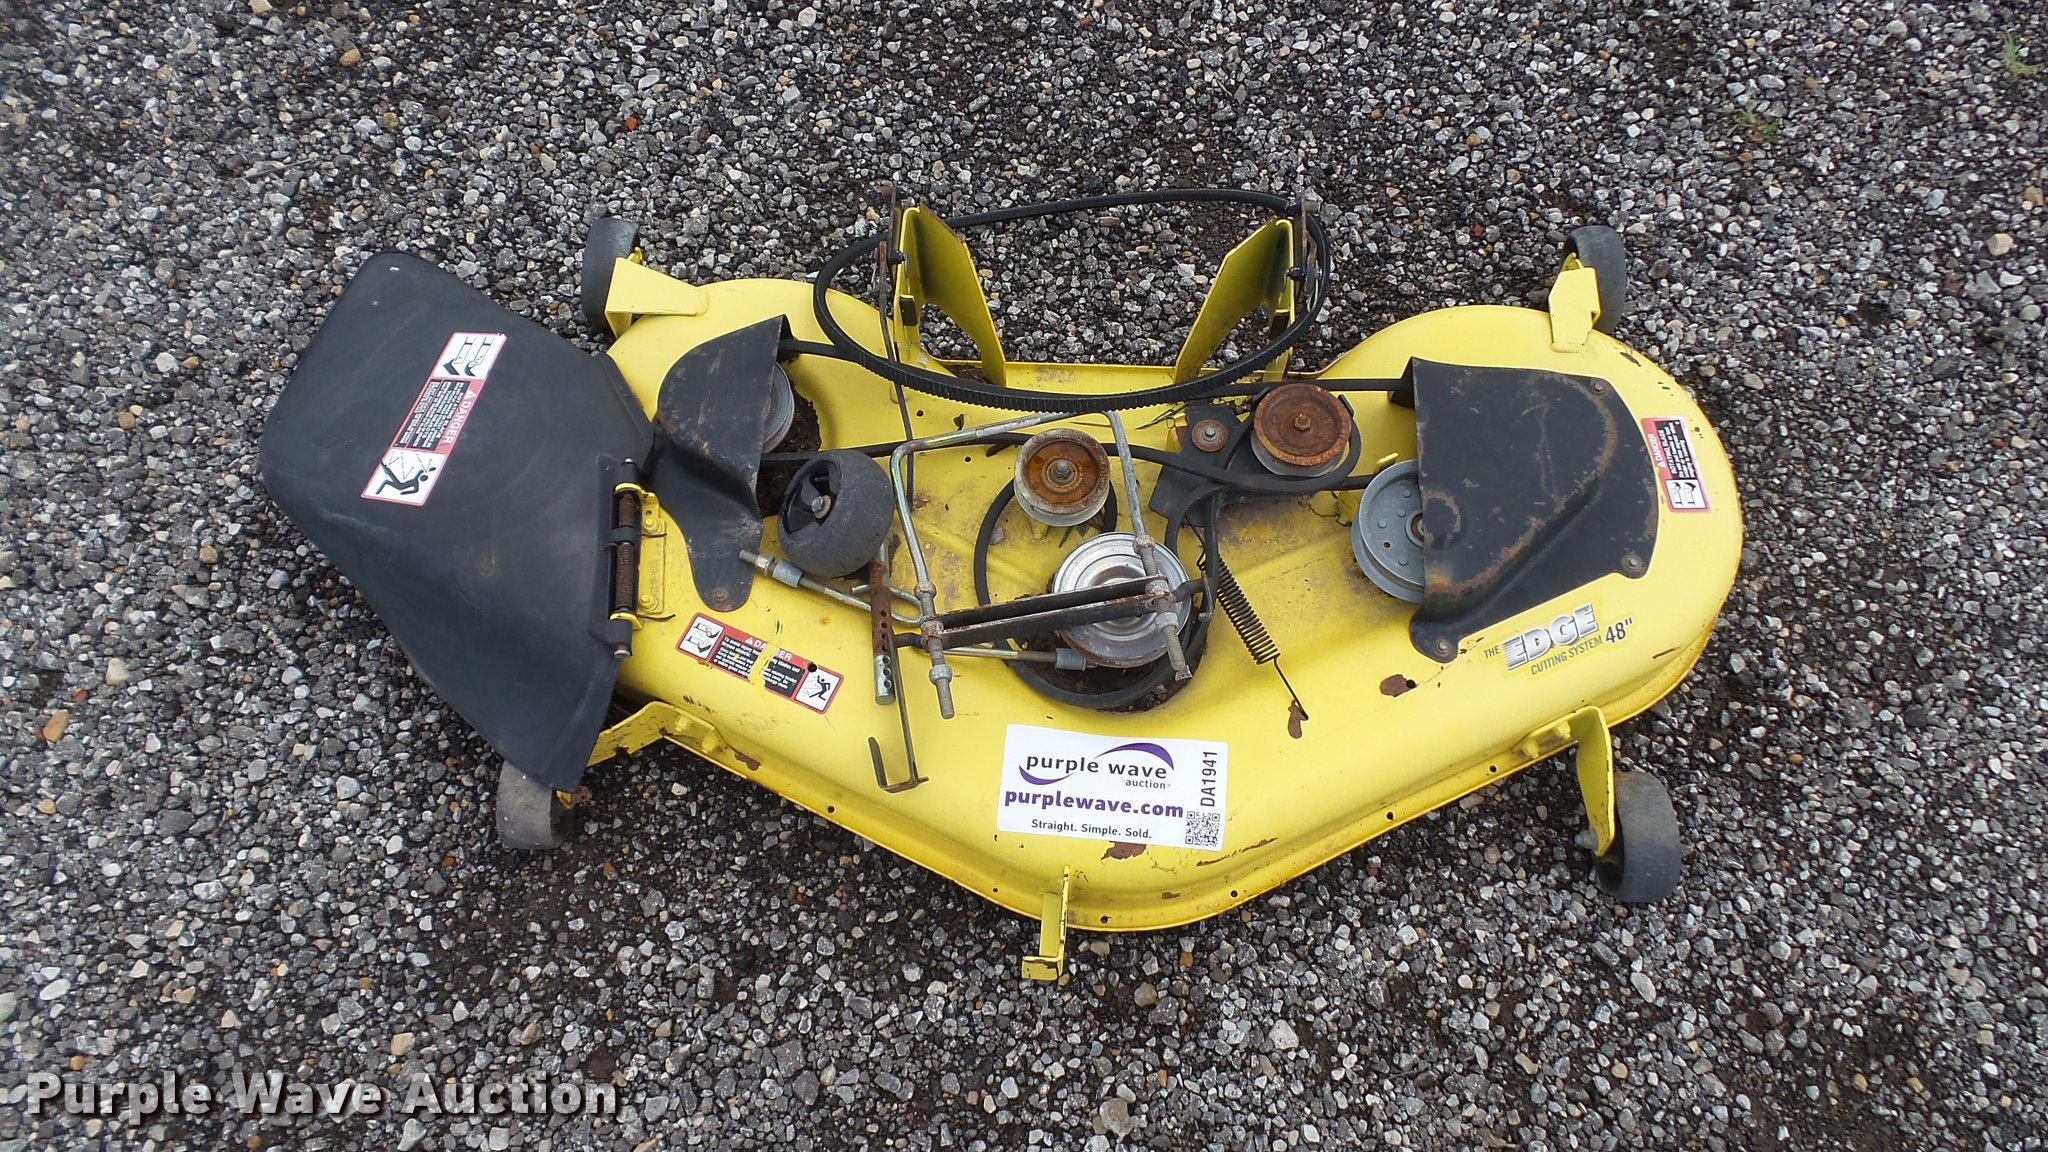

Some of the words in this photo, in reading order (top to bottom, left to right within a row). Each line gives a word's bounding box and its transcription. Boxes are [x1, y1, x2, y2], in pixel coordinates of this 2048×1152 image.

[442, 401, 472, 443] DANGER
[1647, 434, 1664, 461] DANGER
[1657, 430, 1669, 446] BLADE
[1663, 448, 1678, 474] ROTATING
[1501, 603, 1599, 671] EDGE
[1605, 617, 1633, 644] 48"
[1483, 645, 1500, 659] THE
[1531, 651, 1568, 675] CUTTING
[1569, 635, 1603, 659] SYSTEM
[1026, 755, 1099, 774] purple
[1108, 762, 1168, 779] wave
[1200, 750, 1218, 808] DA1941
[1125, 779, 1166, 790] auction
[1004, 790, 1184, 818] purplewave.com
[1031, 818, 1077, 833] Straight.
[1081, 823, 1121, 837] Simple.
[1125, 827, 1152, 839] Sold.
